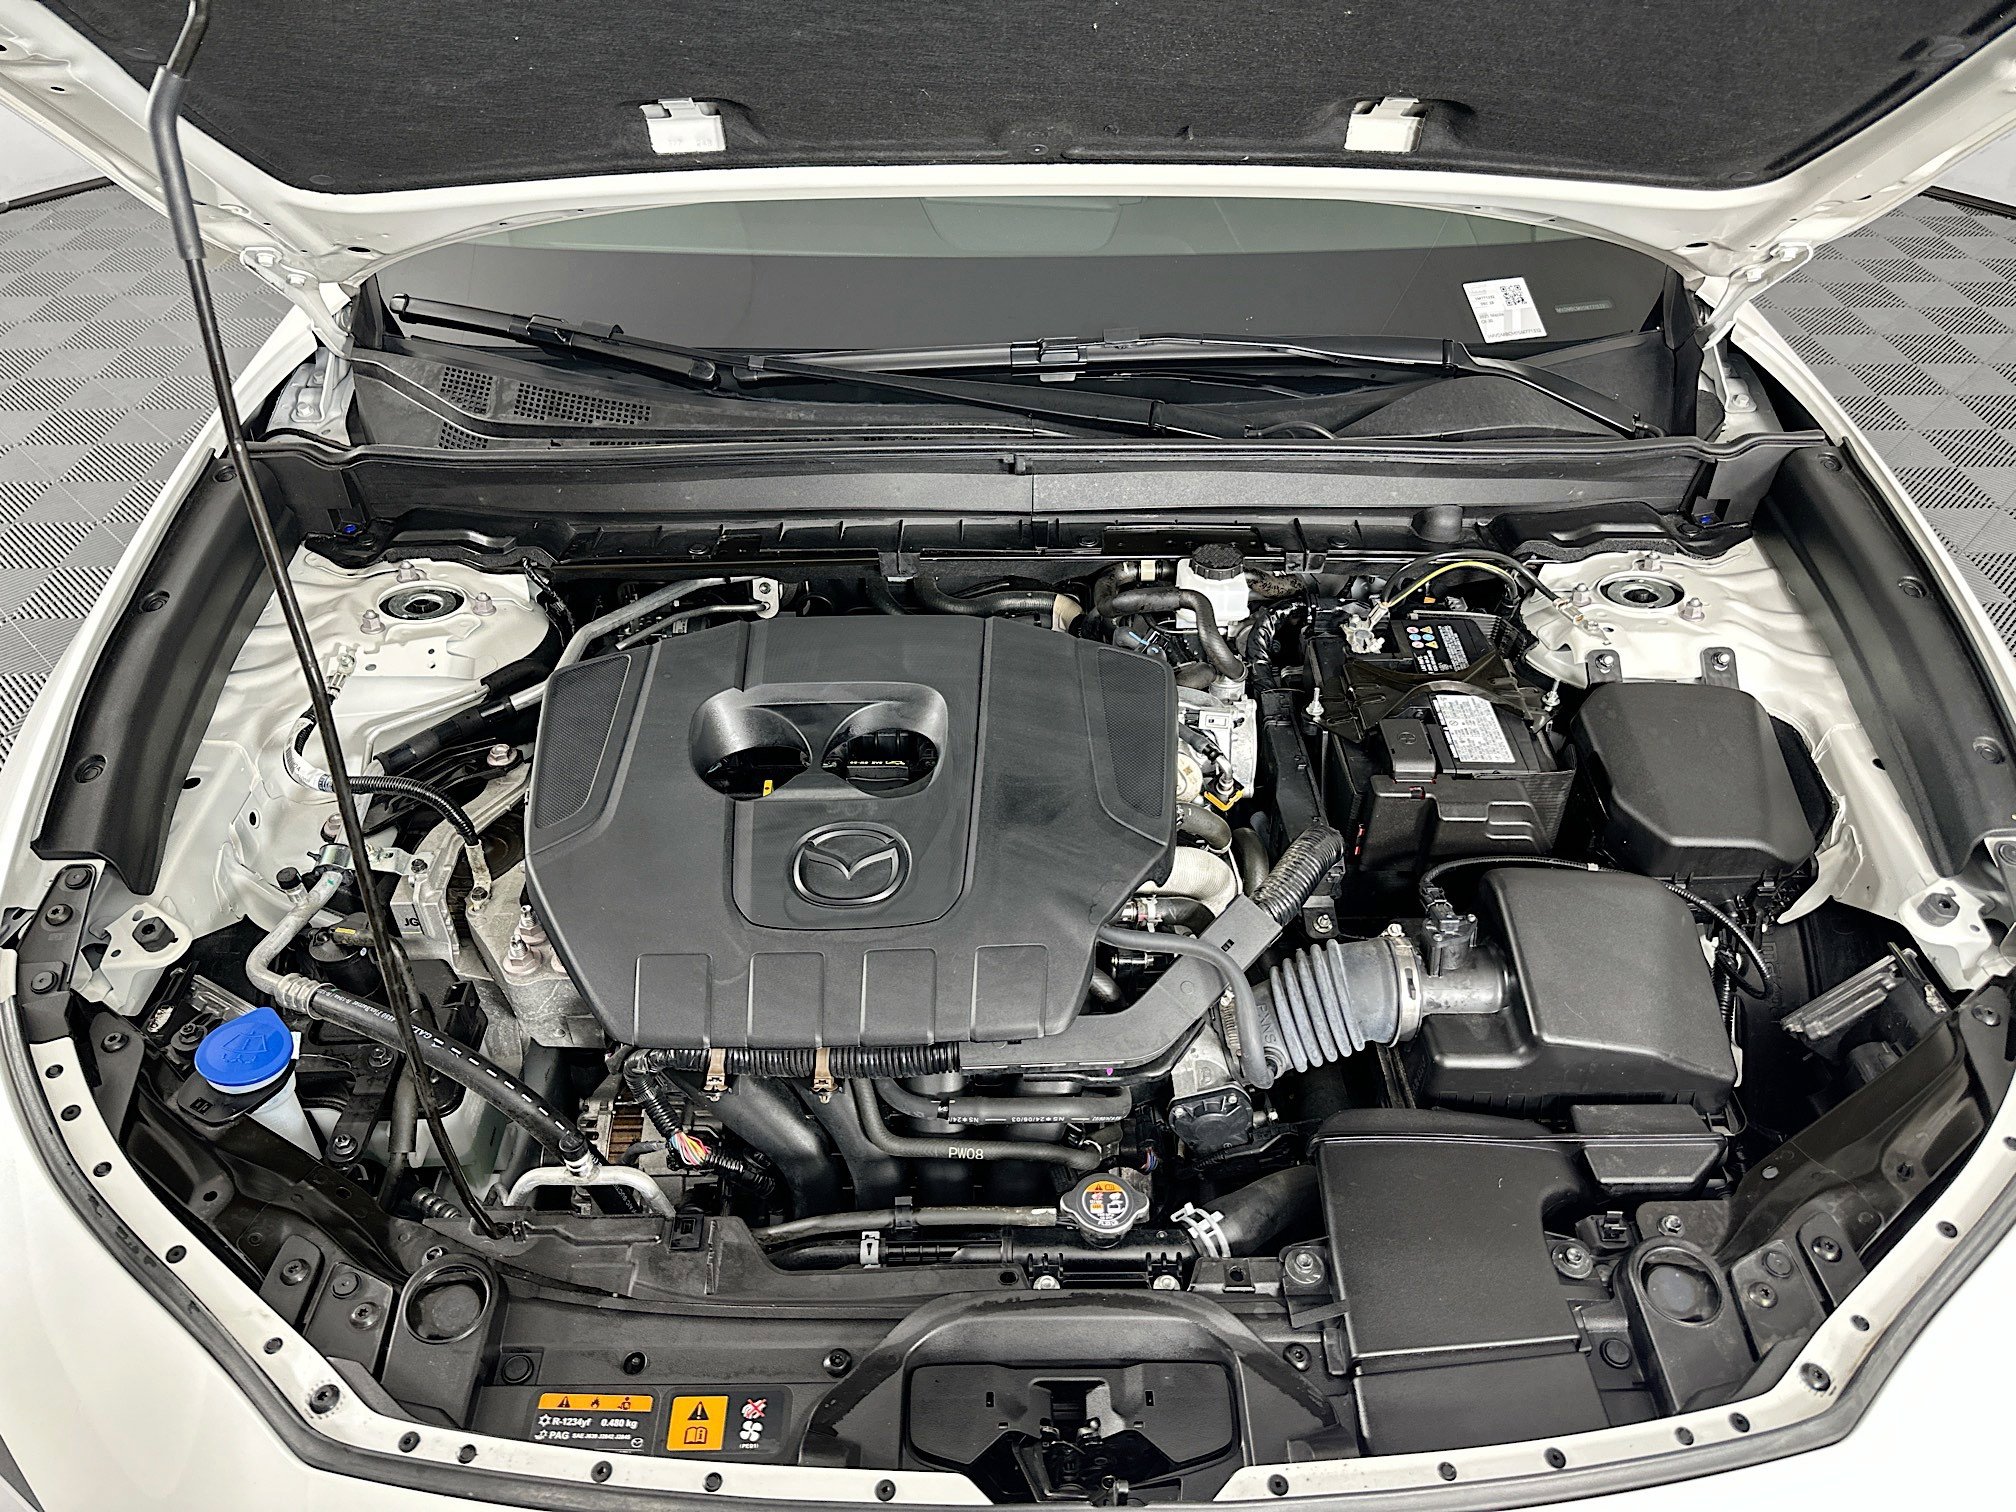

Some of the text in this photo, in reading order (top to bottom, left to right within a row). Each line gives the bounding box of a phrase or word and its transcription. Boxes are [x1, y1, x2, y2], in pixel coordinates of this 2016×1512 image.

[948, 1146, 984, 1160] PW08
[552, 1417, 638, 1429] R-1234yf 0.480 kg
[548, 1431, 570, 1440] PAG
